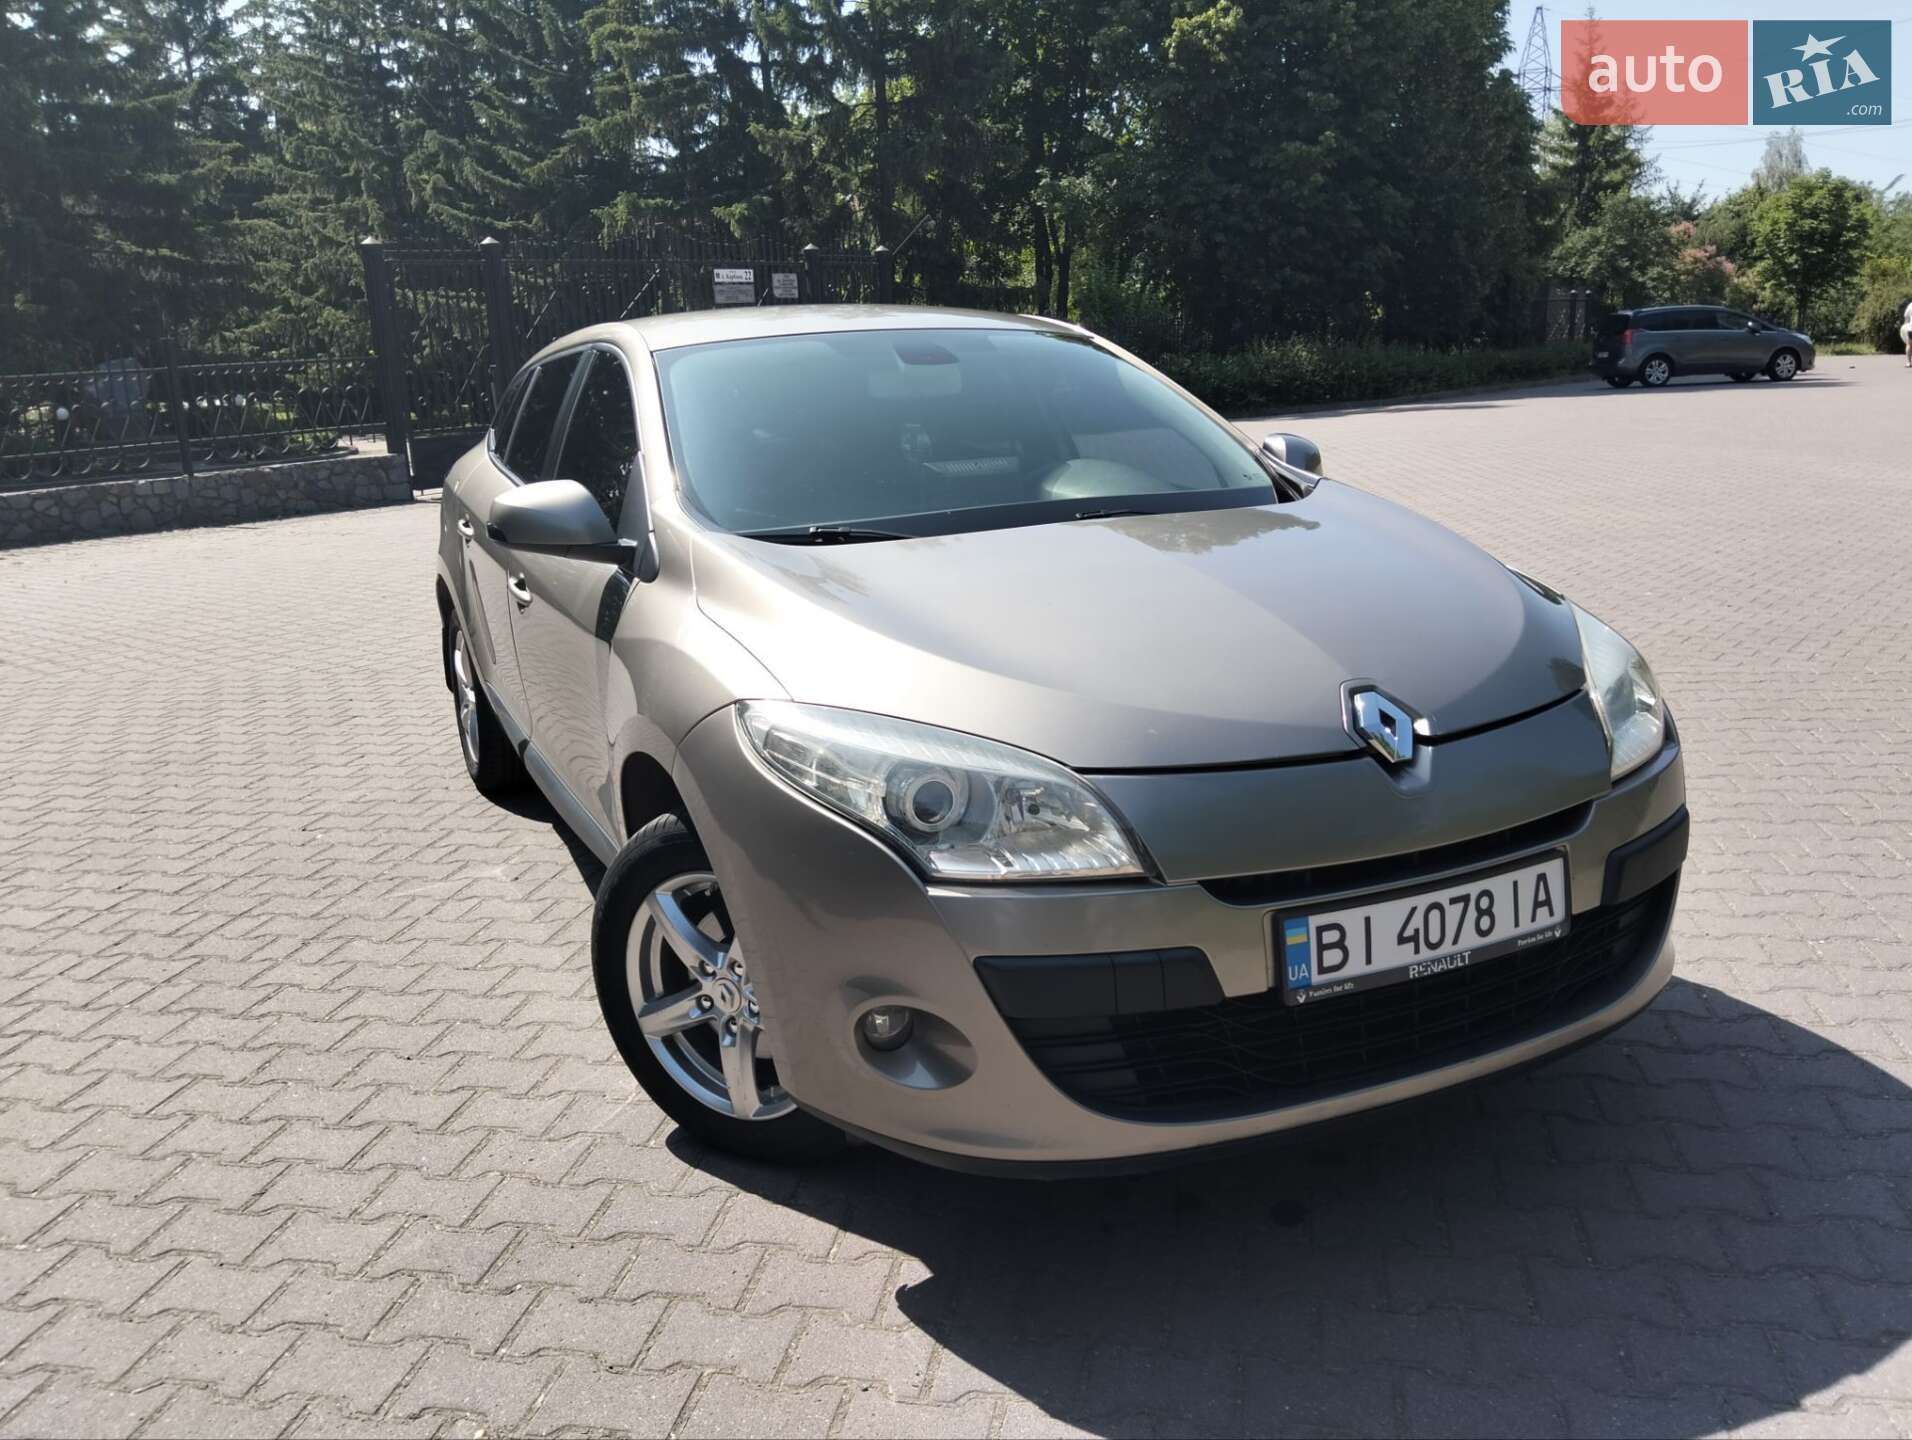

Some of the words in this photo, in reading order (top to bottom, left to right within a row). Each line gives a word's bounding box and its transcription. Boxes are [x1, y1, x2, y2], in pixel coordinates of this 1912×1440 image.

[744, 270, 752, 281] 22
[1315, 915, 1373, 976] BI
[1397, 888, 1496, 956] 4078
[1512, 872, 1555, 929] IA
[1287, 963, 1310, 982] UA
[1408, 951, 1472, 979] RENAULT
